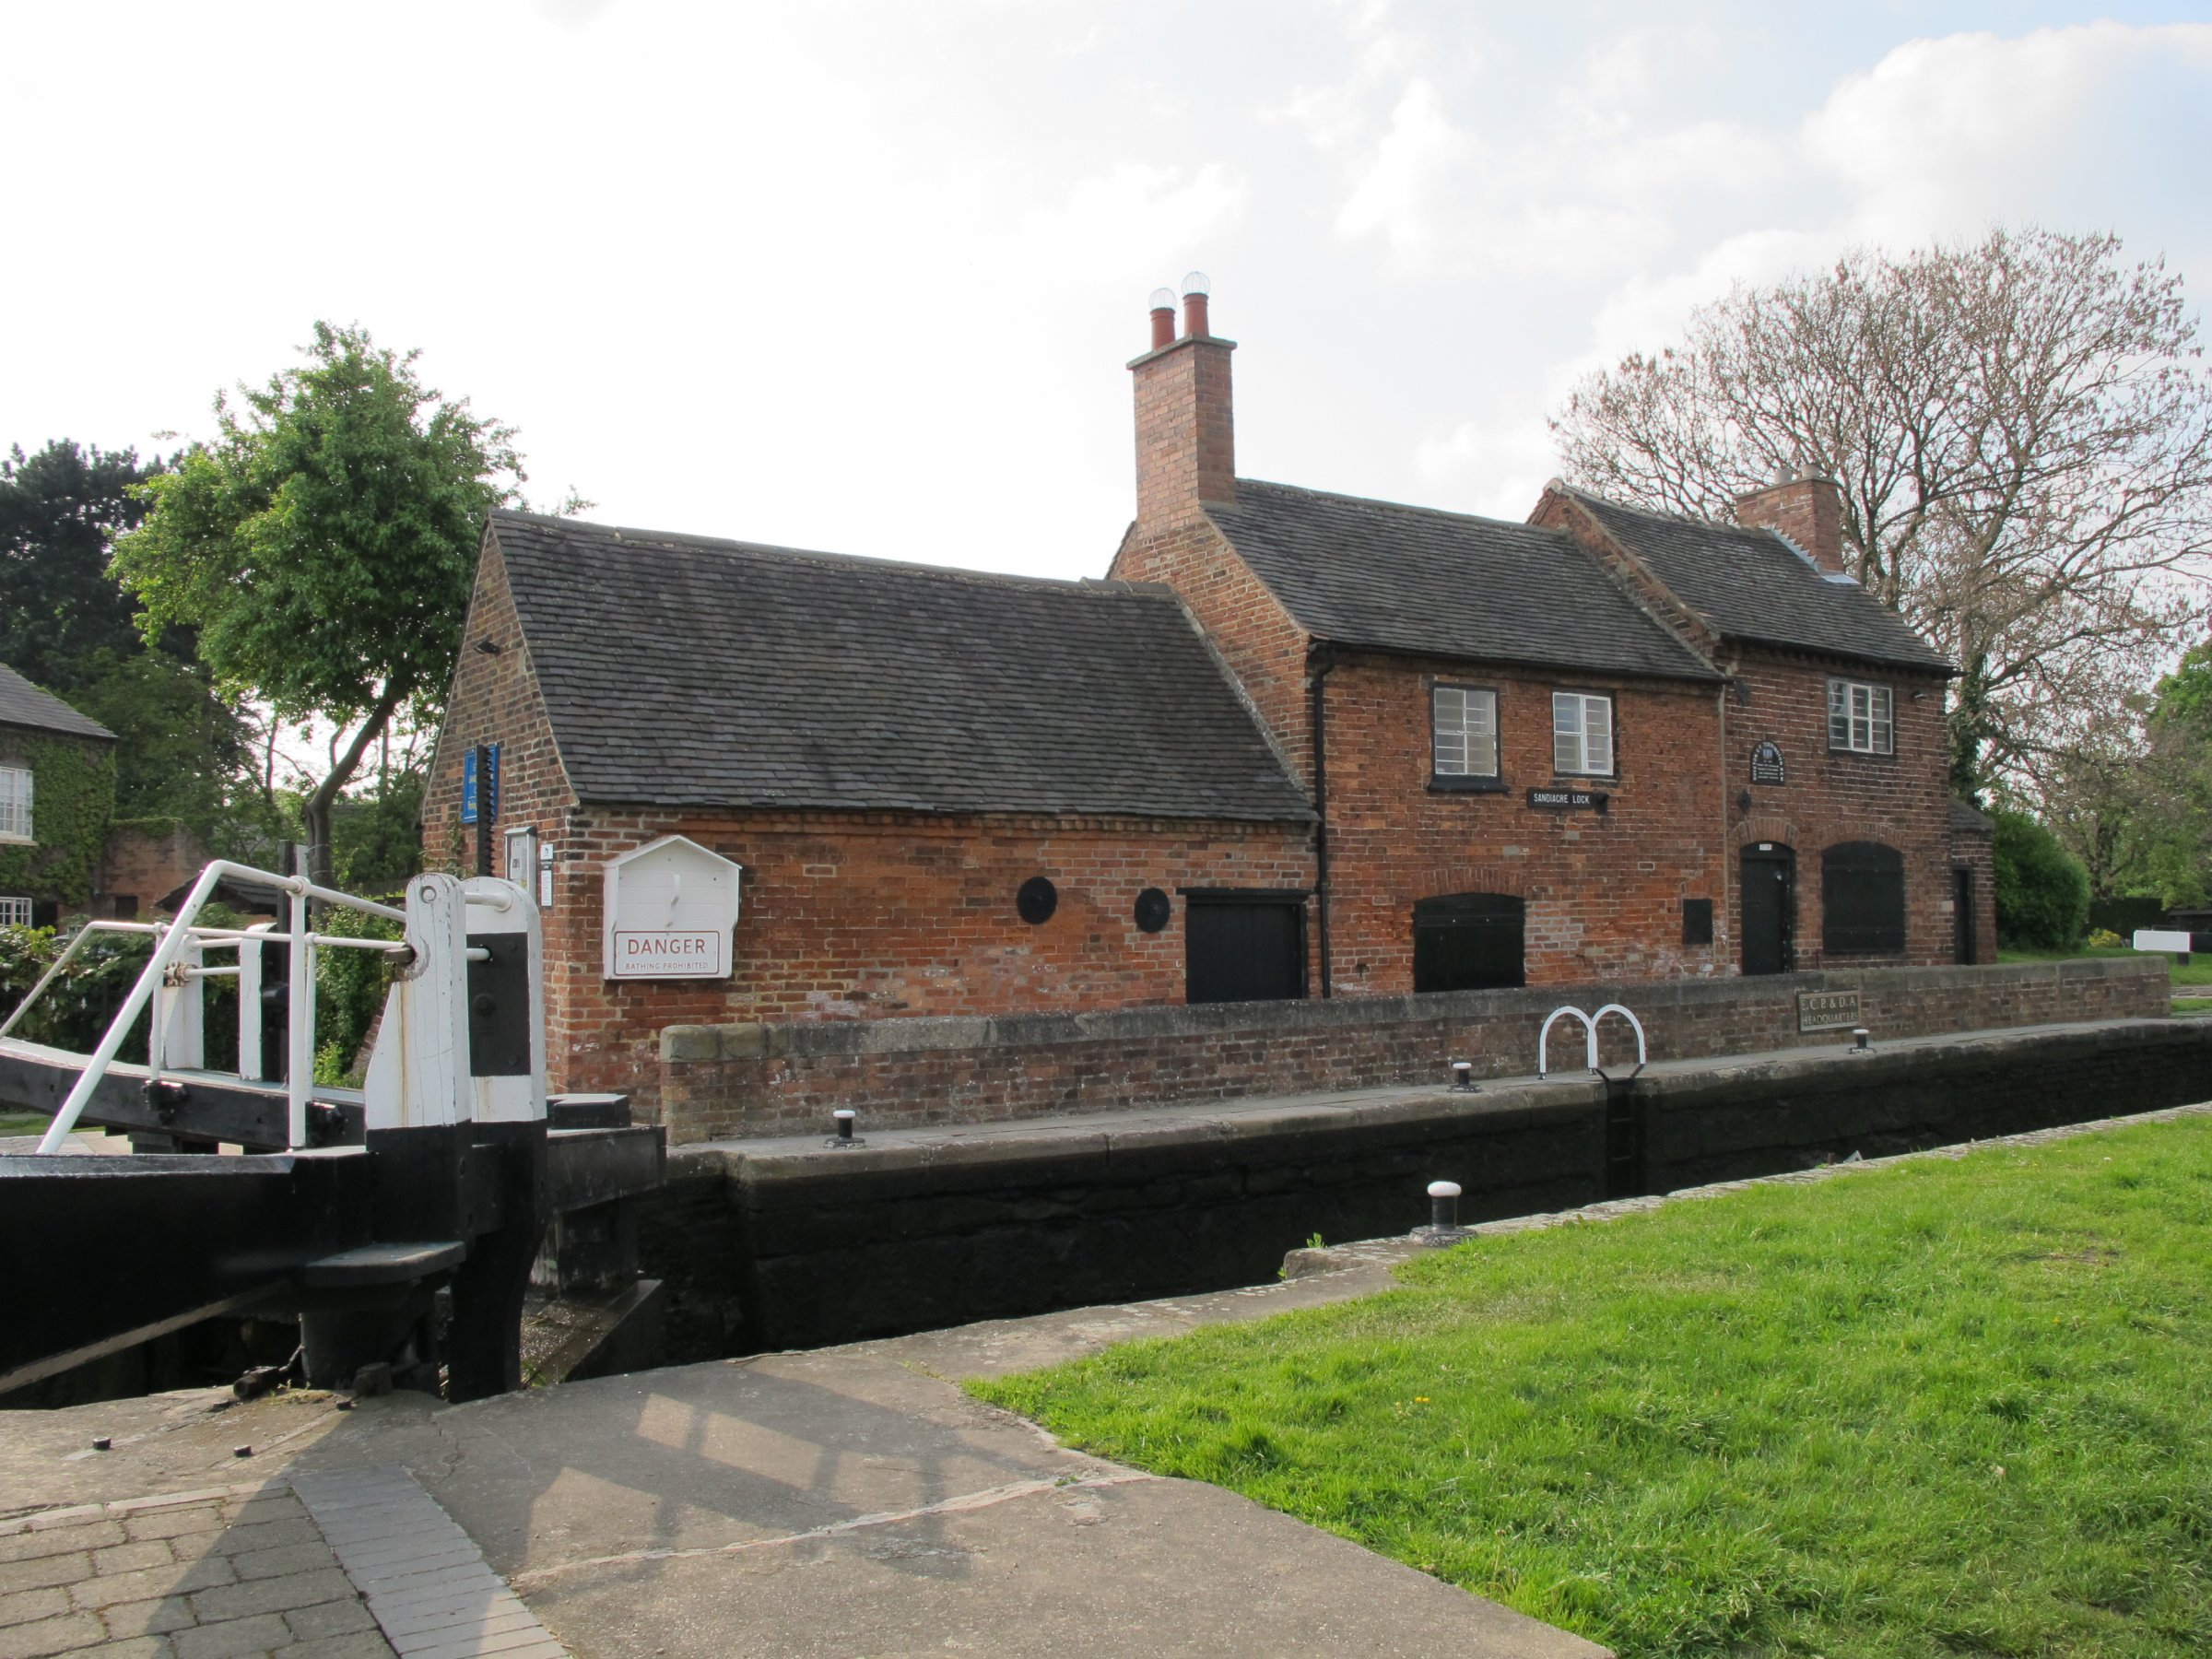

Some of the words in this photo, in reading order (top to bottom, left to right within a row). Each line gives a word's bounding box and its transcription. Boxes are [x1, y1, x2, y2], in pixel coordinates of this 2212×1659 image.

[1534, 793, 1569, 804] SANDIACRE
[1572, 794, 1590, 805] LOCK
[628, 939, 705, 955] DANGER
[626, 962, 661, 971] BATHING
[664, 961, 709, 970] PROHIBITED
[1830, 997, 1836, 1009] &
[1803, 1012, 1858, 1025] HEADQUARTERS
